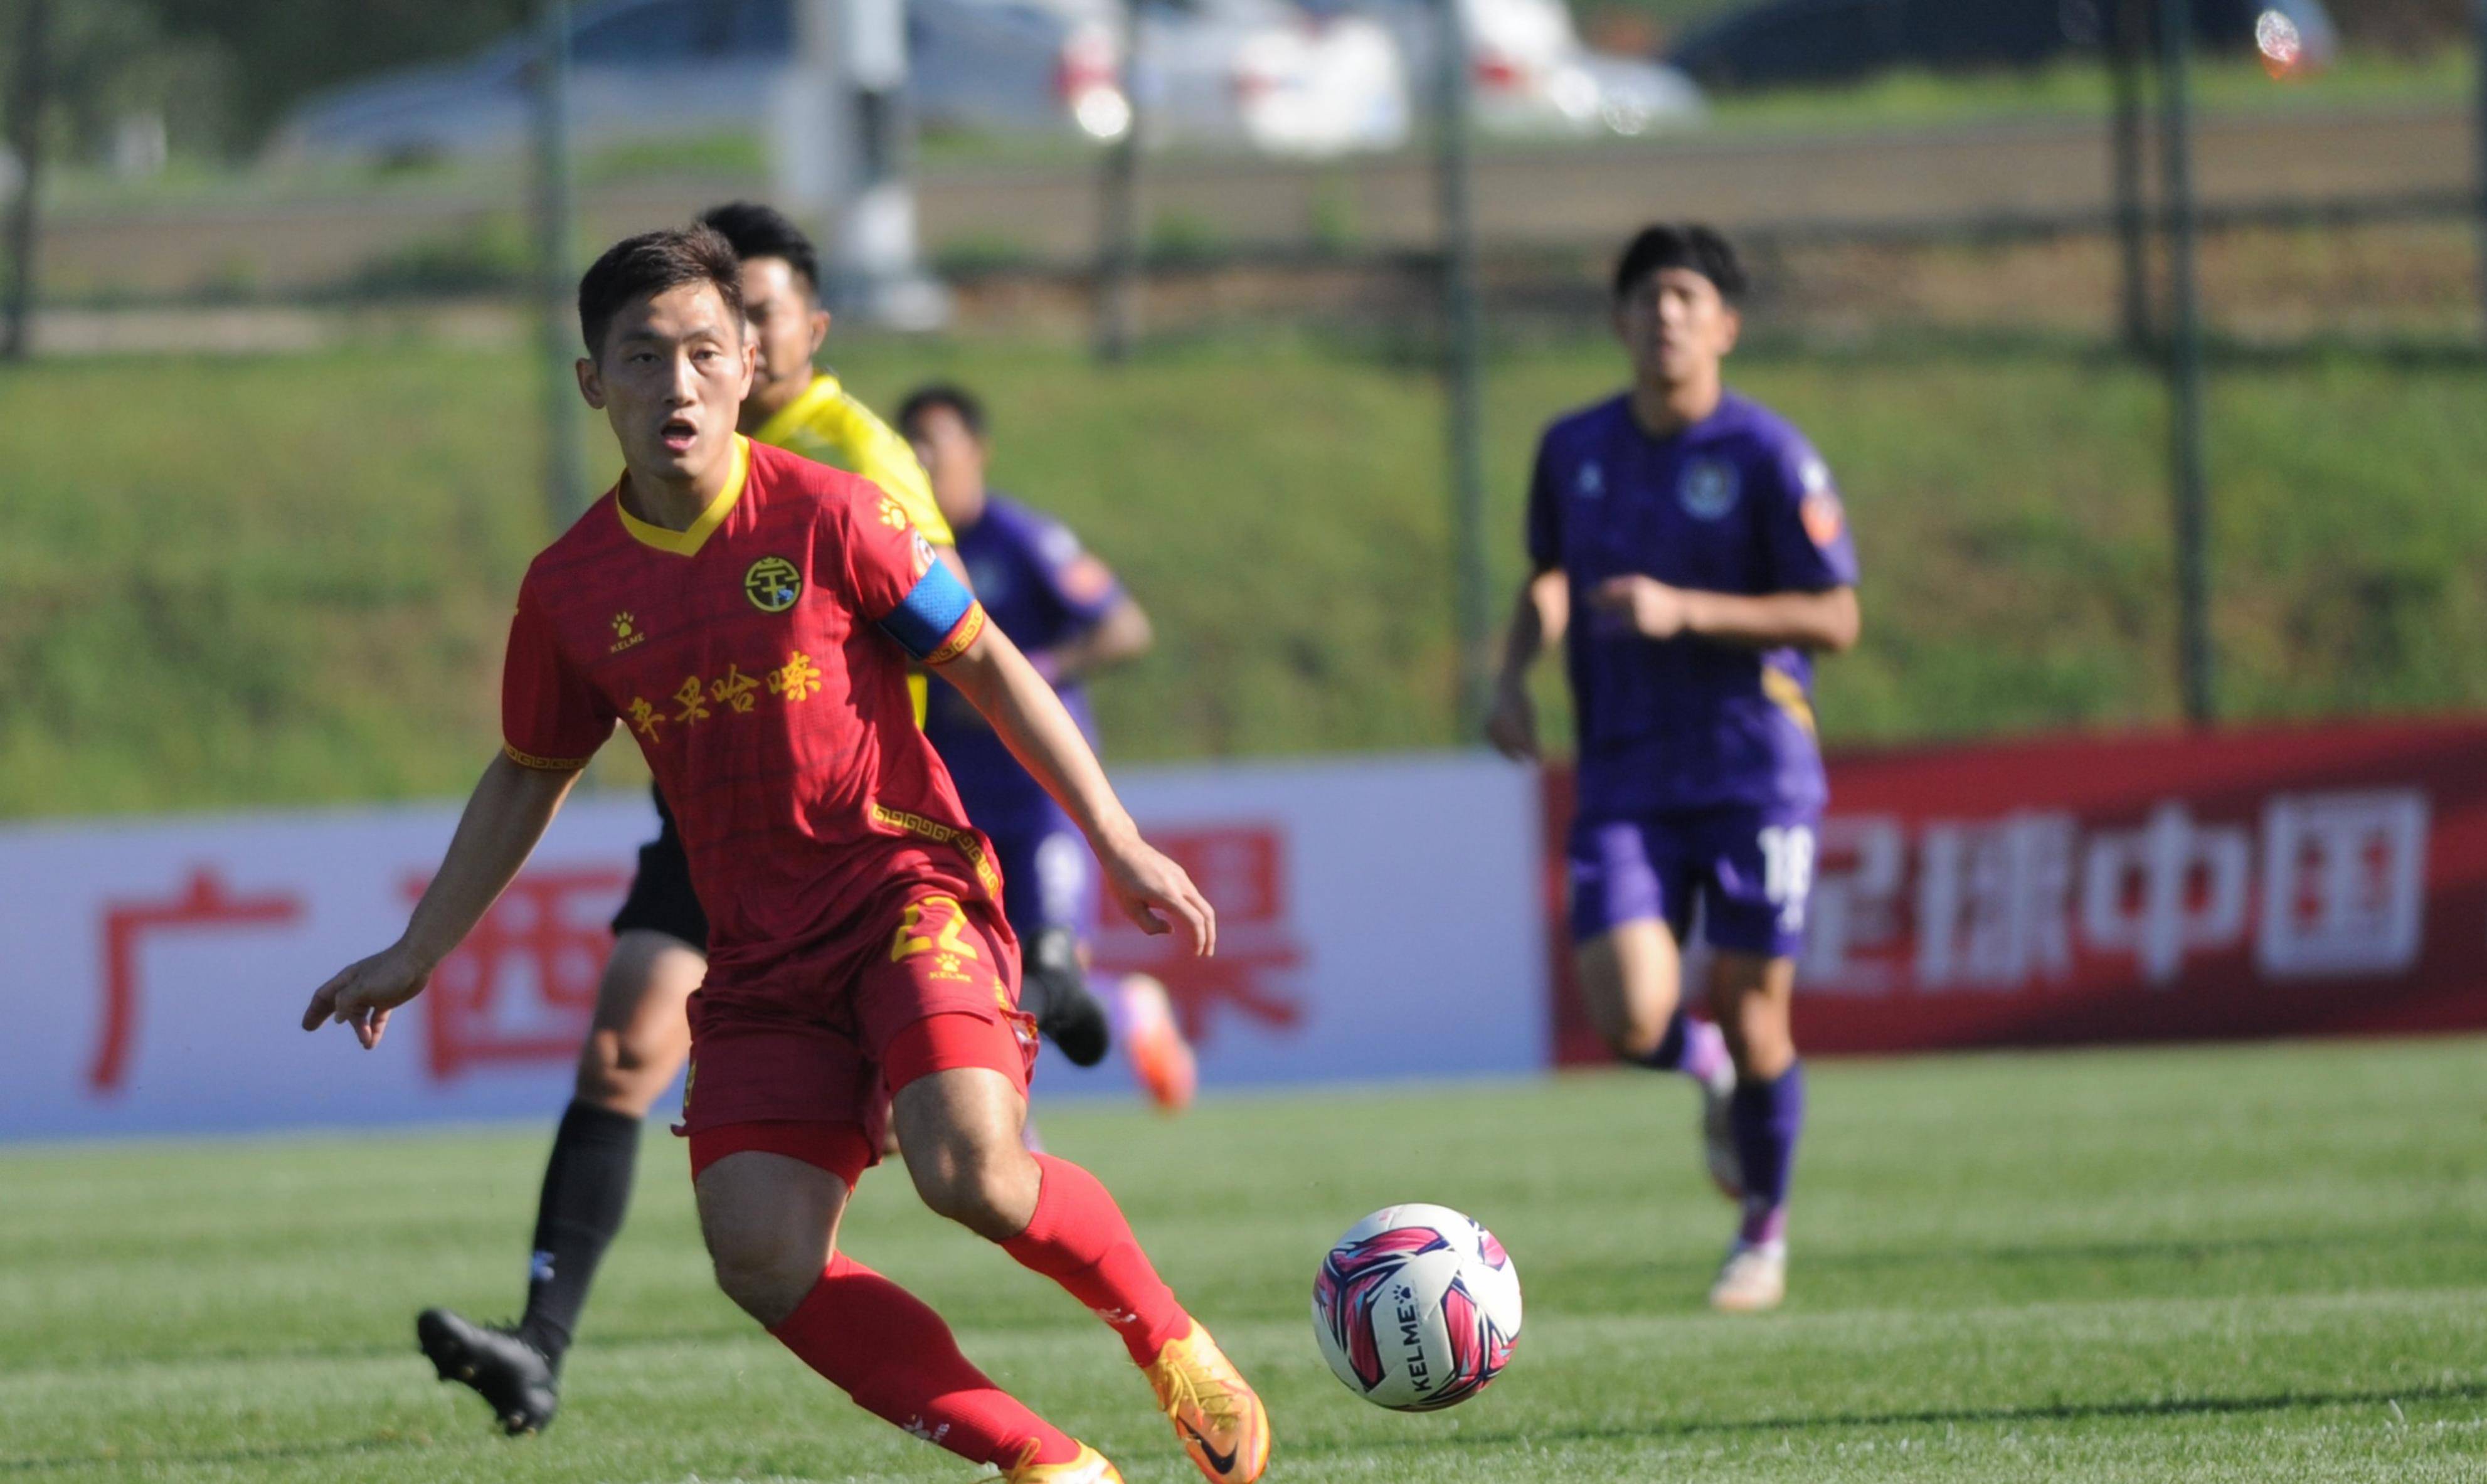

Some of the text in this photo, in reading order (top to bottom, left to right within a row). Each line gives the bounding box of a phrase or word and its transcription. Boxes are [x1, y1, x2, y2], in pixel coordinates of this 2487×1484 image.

[610, 632, 645, 654] KELME
[891, 896, 978, 963] 22
[929, 972, 973, 983] KELME
[1397, 1304, 1432, 1392] KELME
